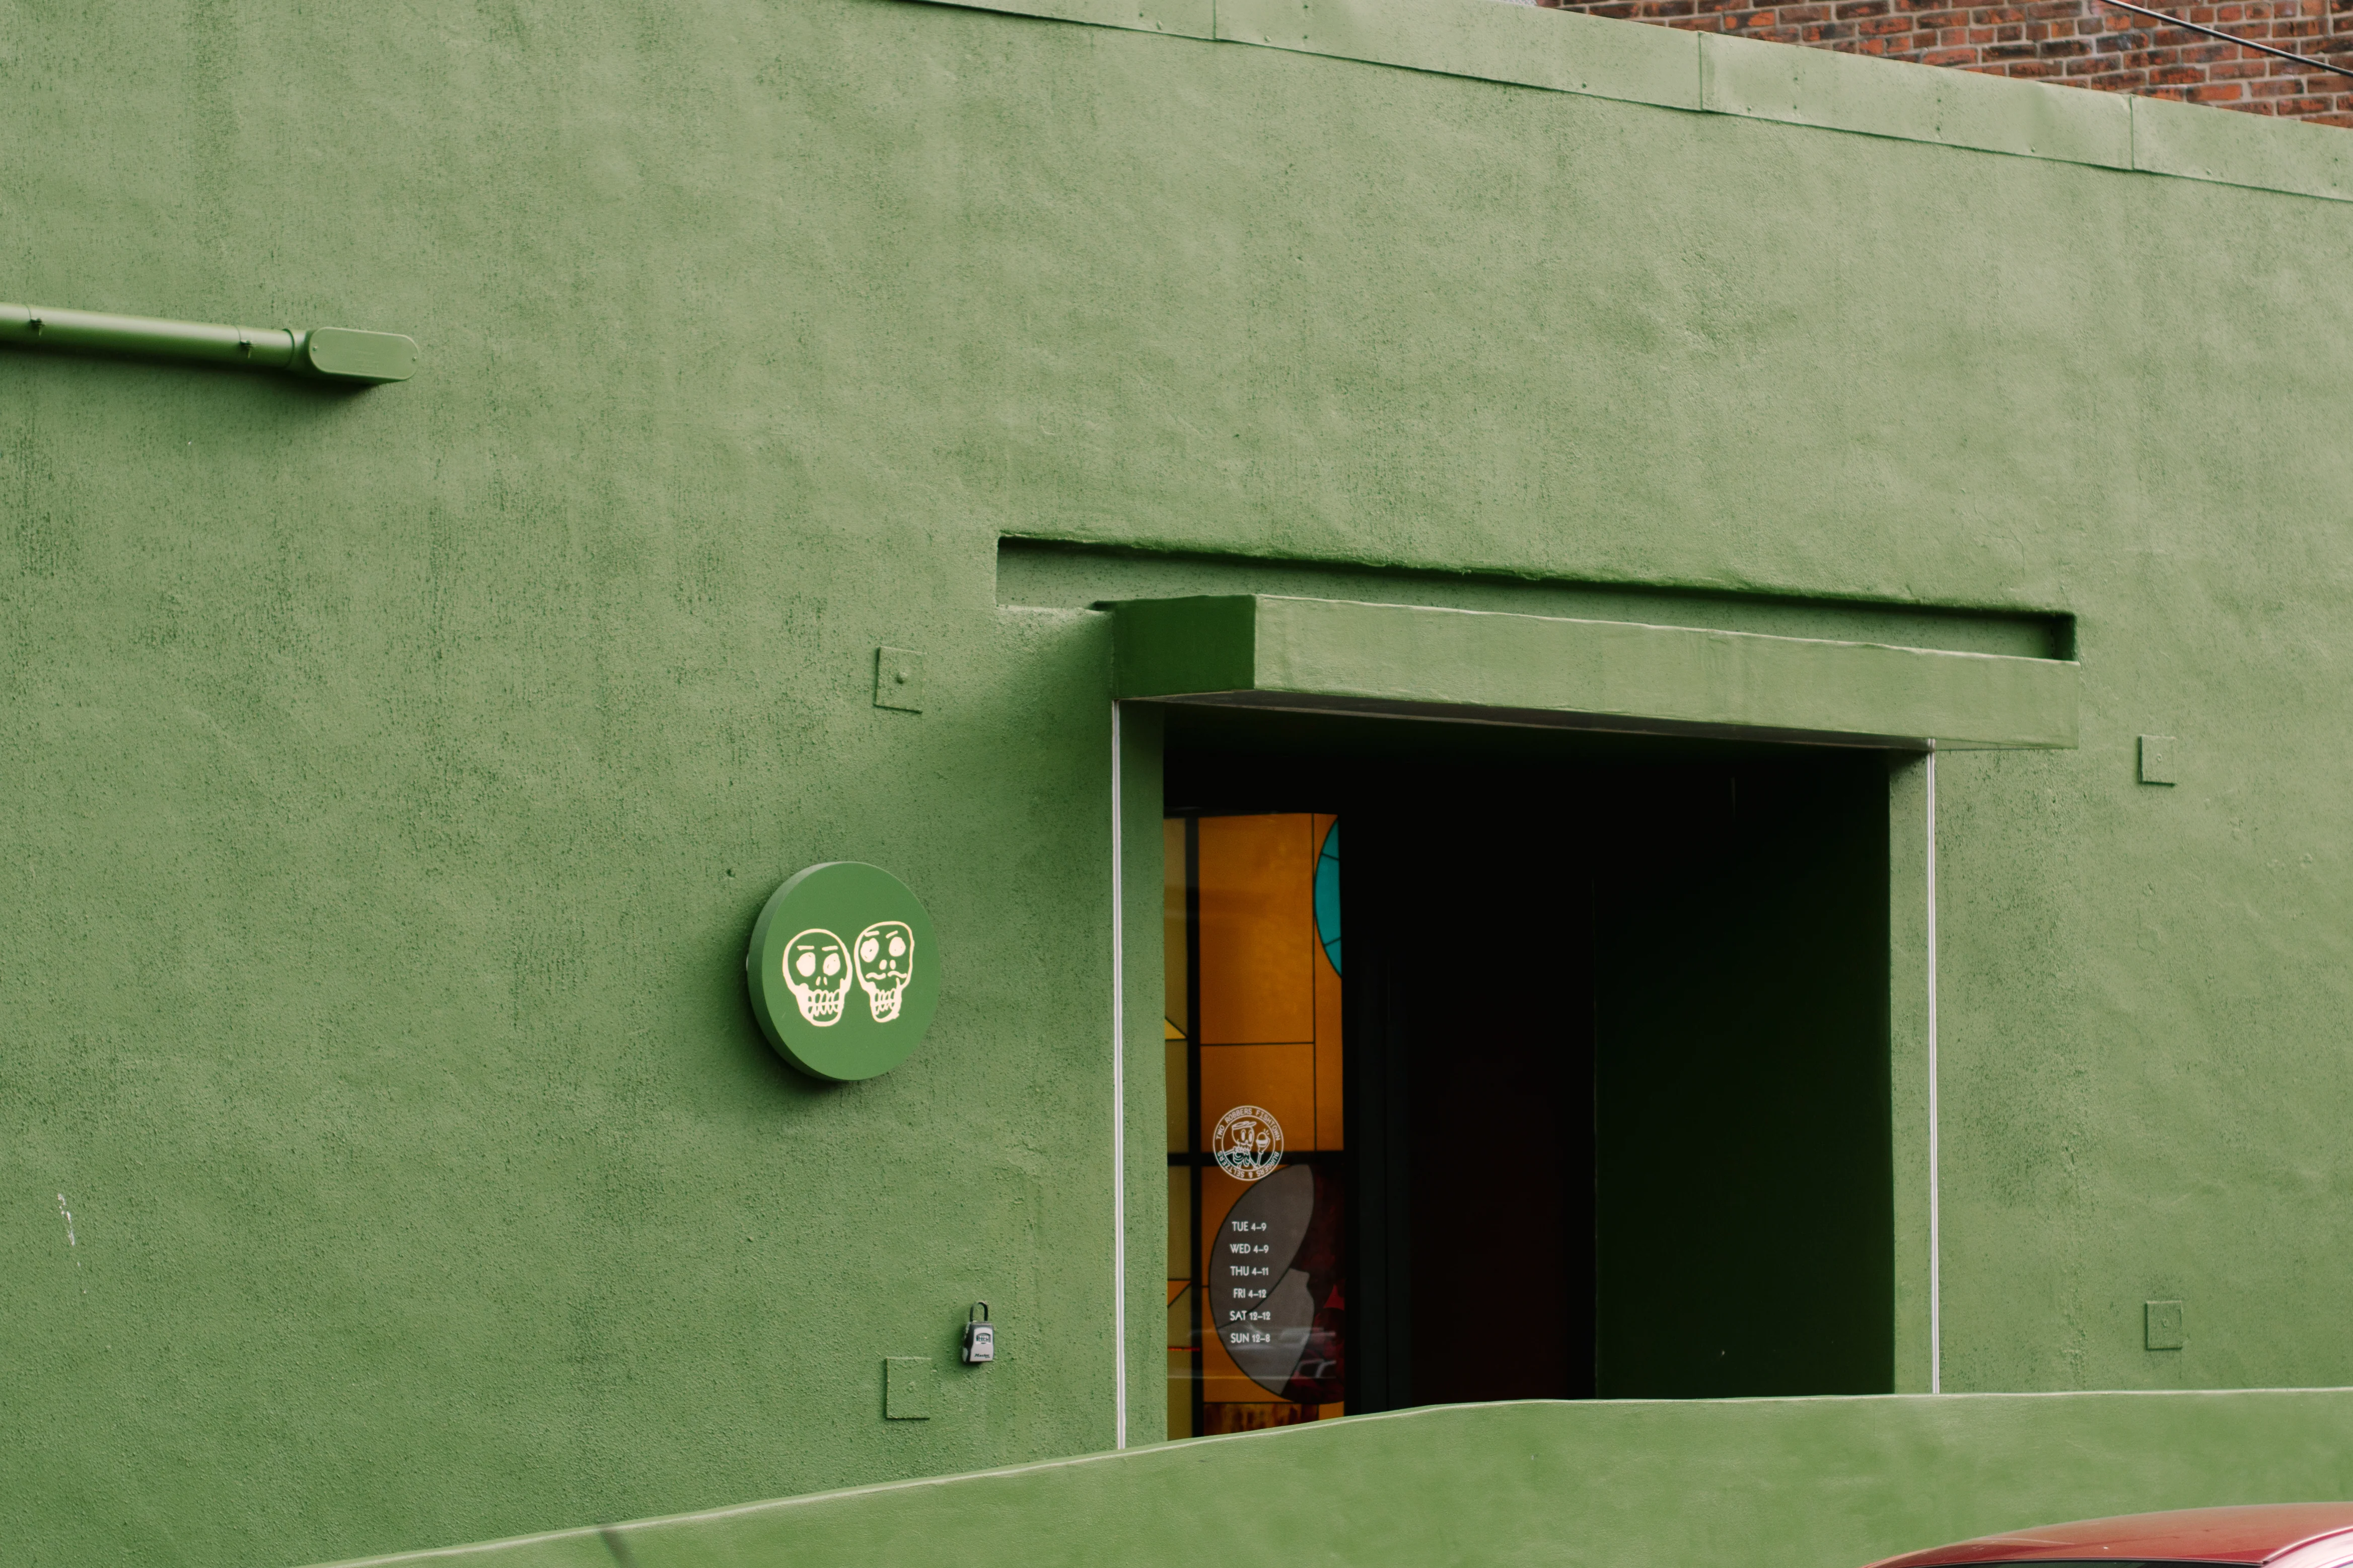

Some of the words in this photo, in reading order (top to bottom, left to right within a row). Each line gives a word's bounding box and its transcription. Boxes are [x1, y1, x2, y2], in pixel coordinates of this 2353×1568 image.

[1216, 1125, 1225, 1140] TWO
[1225, 1108, 1252, 1124] ROBBERS
[1256, 1110, 1280, 1141] FISHTOWN
[1218, 1151, 1245, 1177] SELTZERS
[1257, 1151, 1279, 1177] BURGERS
[1232, 1221, 1249, 1232] TUE
[1230, 1243, 1251, 1254] WED
[1230, 1265, 1249, 1276] THU
[1233, 1288, 1246, 1298] FRI
[1230, 1310, 1247, 1321] SAT
[1231, 1333, 1249, 1343] SUN
